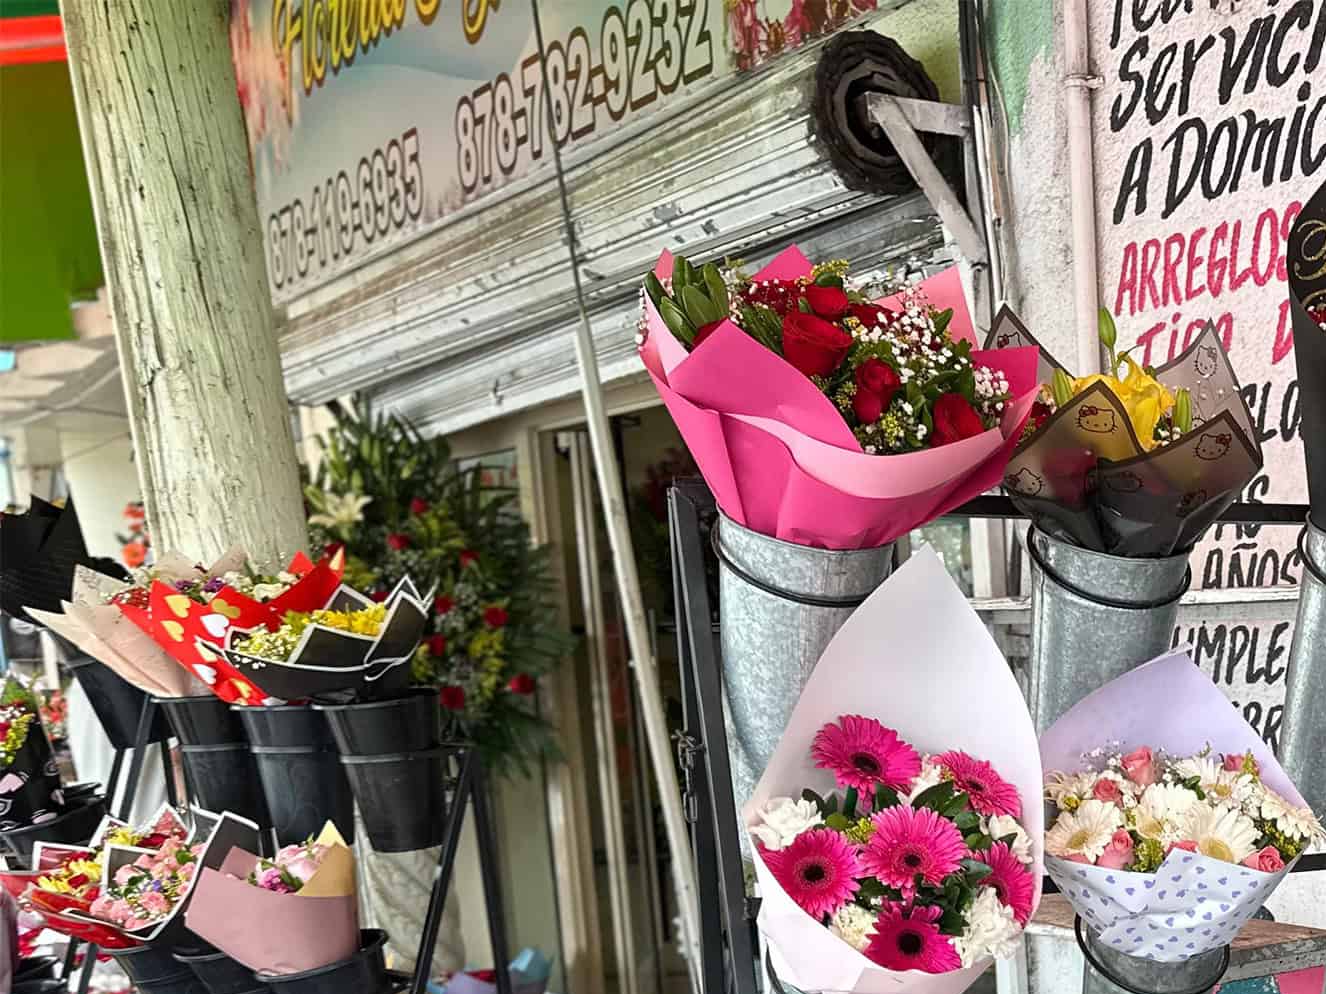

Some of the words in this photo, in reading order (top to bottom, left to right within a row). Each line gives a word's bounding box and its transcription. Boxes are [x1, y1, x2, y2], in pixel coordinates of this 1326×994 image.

[456, 0, 713, 195] 878-782-9232
[268, 126, 424, 289] 878-119-6935
[1112, 137, 1152, 225] A
